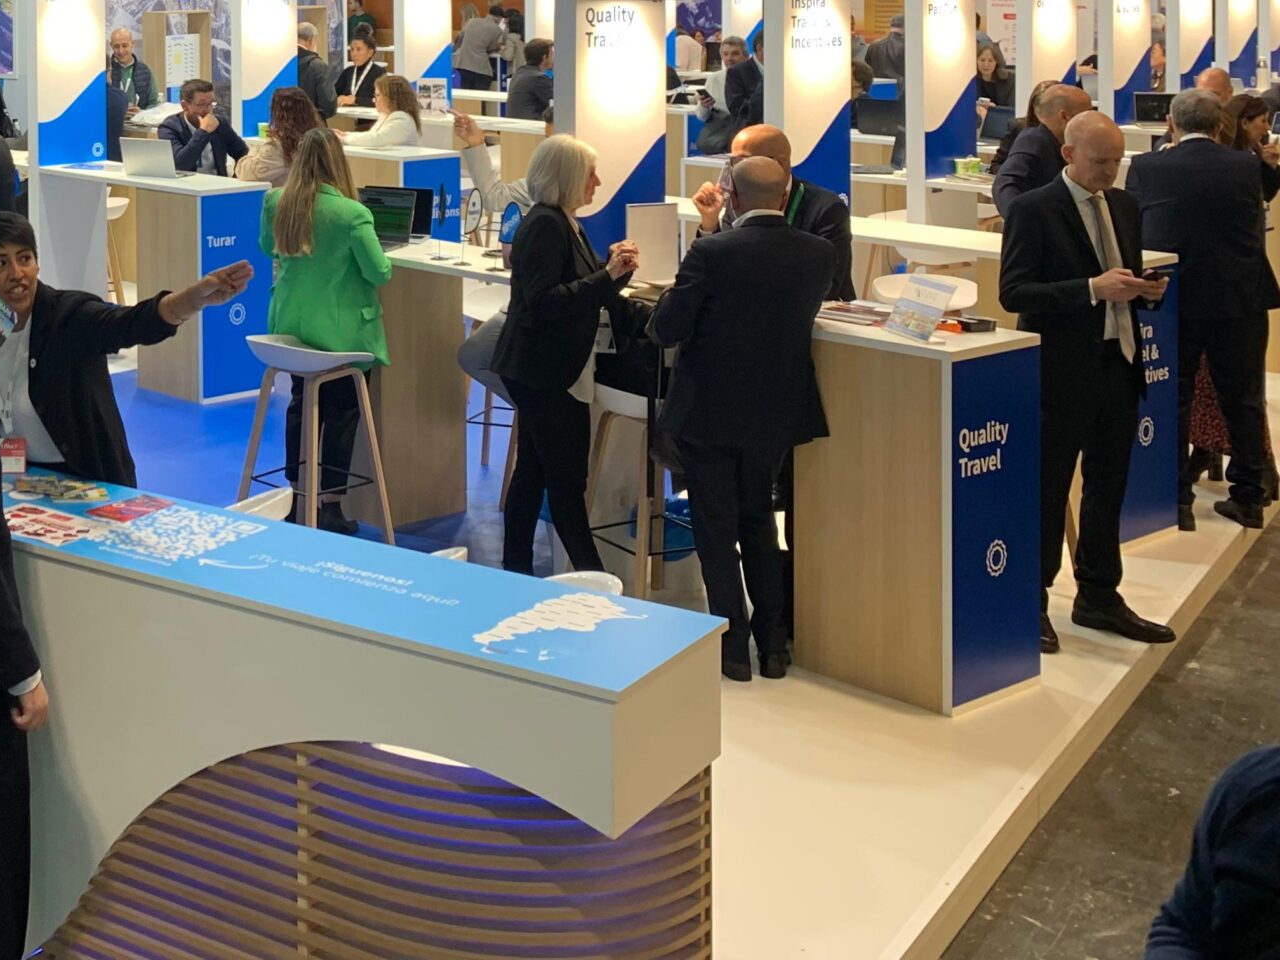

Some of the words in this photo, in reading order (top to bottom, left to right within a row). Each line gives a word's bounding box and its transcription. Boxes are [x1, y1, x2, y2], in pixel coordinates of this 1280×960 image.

[586, 6, 635, 26] Quality
[206, 234, 236, 249] Turar
[959, 421, 1009, 452] Quality
[959, 449, 1002, 478] Travel
[282, 559, 320, 574] viaje
[323, 571, 408, 595] comienza
